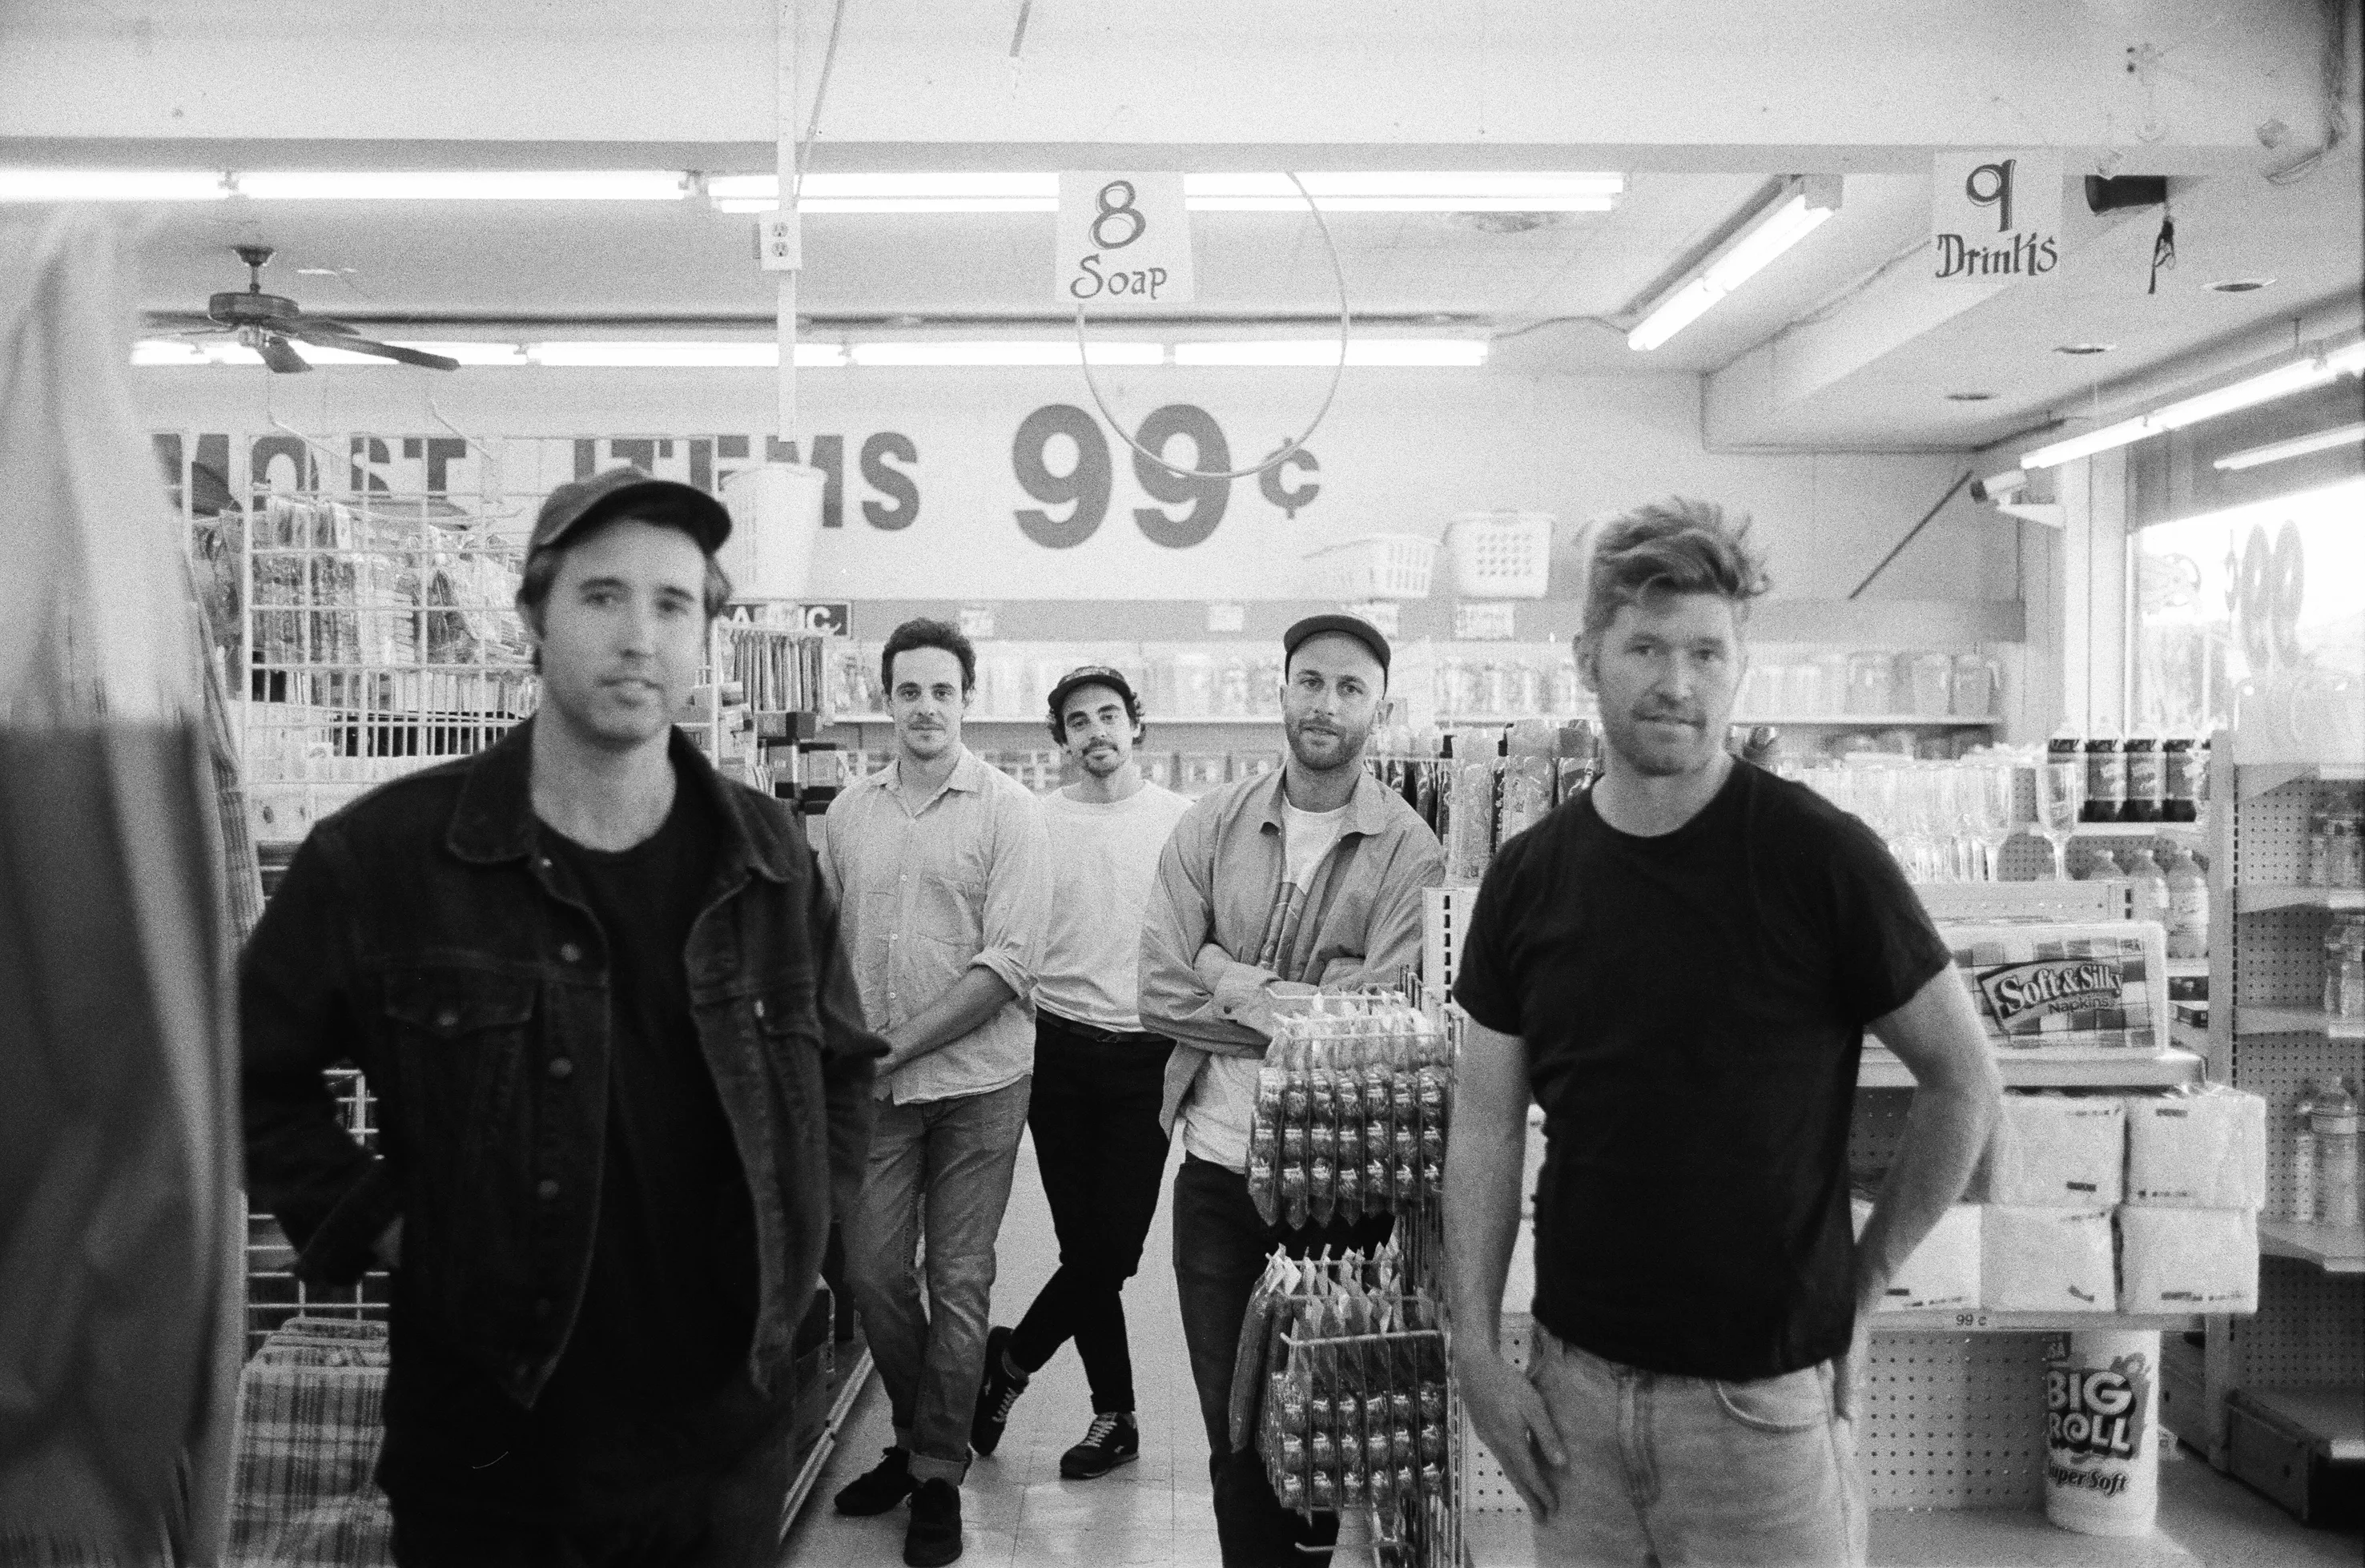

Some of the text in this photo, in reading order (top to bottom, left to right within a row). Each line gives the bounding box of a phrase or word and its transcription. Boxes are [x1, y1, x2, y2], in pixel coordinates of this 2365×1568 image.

[1088, 179, 1147, 251] 8
[1965, 158, 2017, 232] 9
[1069, 253, 1168, 301] Soap
[1934, 231, 2058, 279] Drinks
[2046, 997, 2110, 1015] Napkins
[2047, 1369, 2133, 1416] BIG
[2048, 1411, 2131, 1453] ROLL
[2089, 1466, 2128, 1496] Soft
